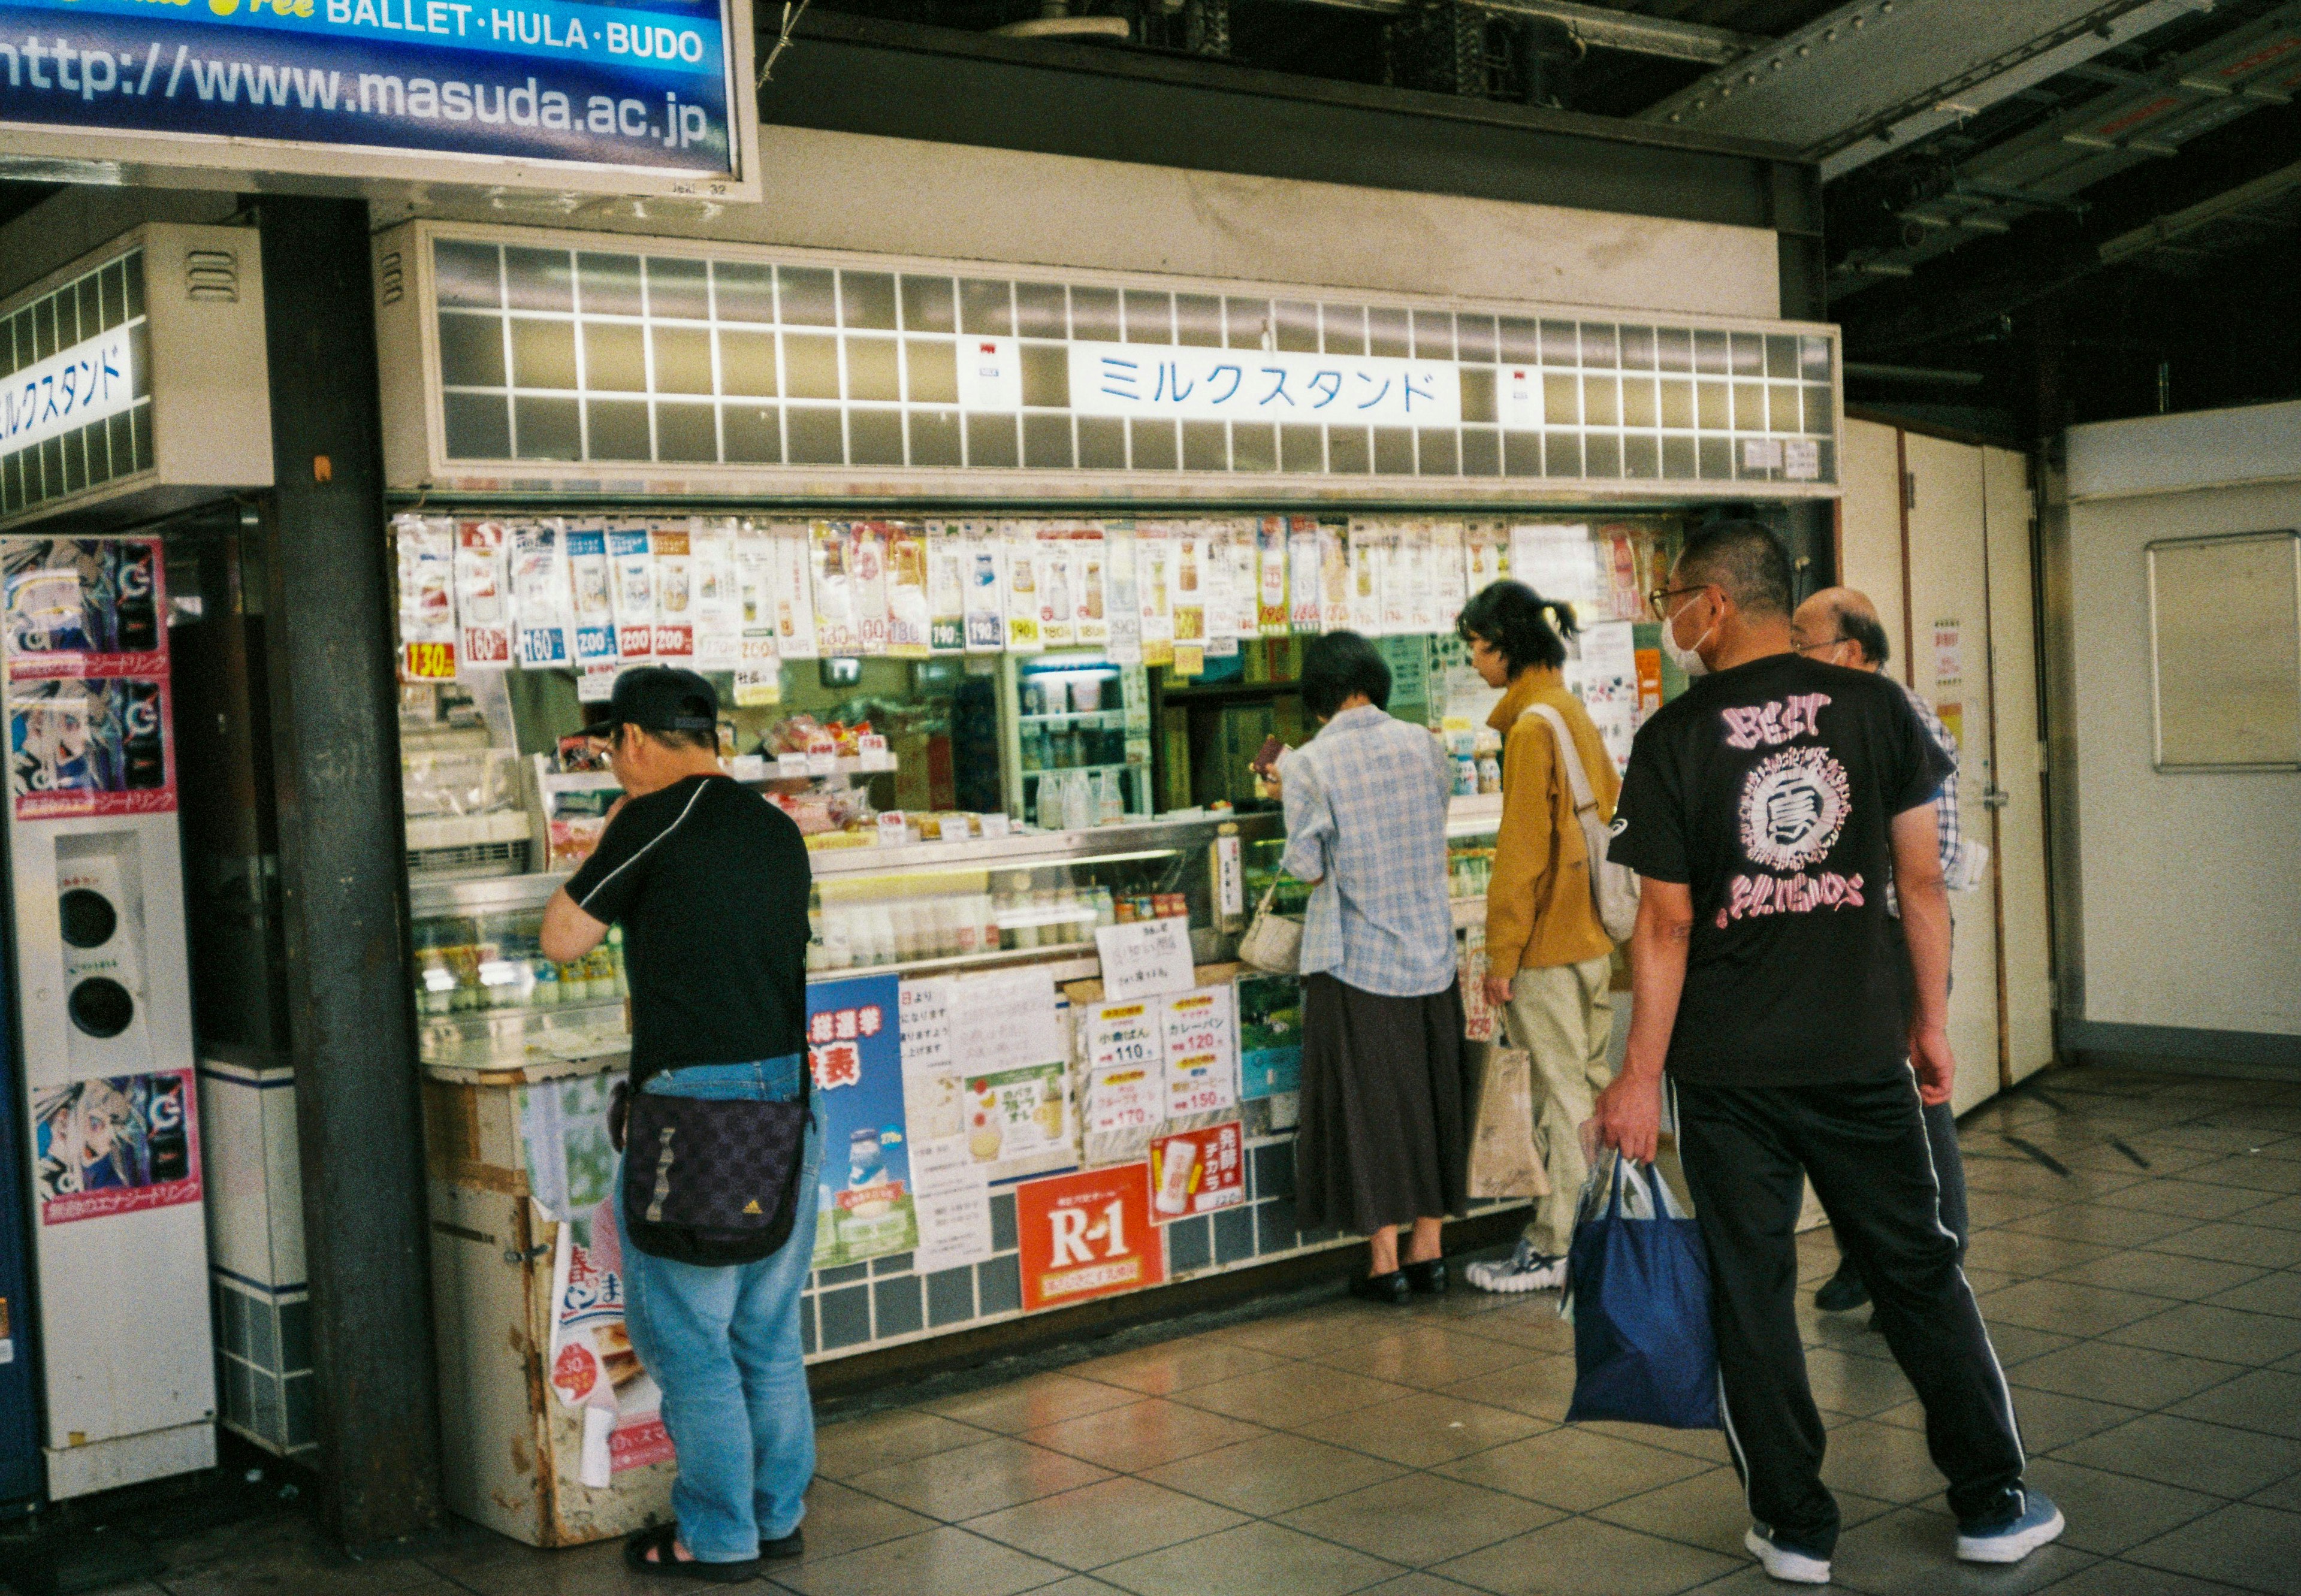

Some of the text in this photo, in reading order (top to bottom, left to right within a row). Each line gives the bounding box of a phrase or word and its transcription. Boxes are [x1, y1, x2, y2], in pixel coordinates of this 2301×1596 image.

[0, 344, 120, 440] ルクスタンド
[1101, 356, 1435, 412] ミルクスタンド
[578, 633, 605, 652] 200
[621, 631, 648, 651] 200
[656, 631, 683, 651] 200
[933, 625, 954, 643] 190
[409, 643, 445, 677] 130
[1187, 1033, 1214, 1050] 120
[1116, 1044, 1143, 1061] 110
[1190, 1091, 1217, 1108] 150
[1047, 1198, 1131, 1269] R-1
